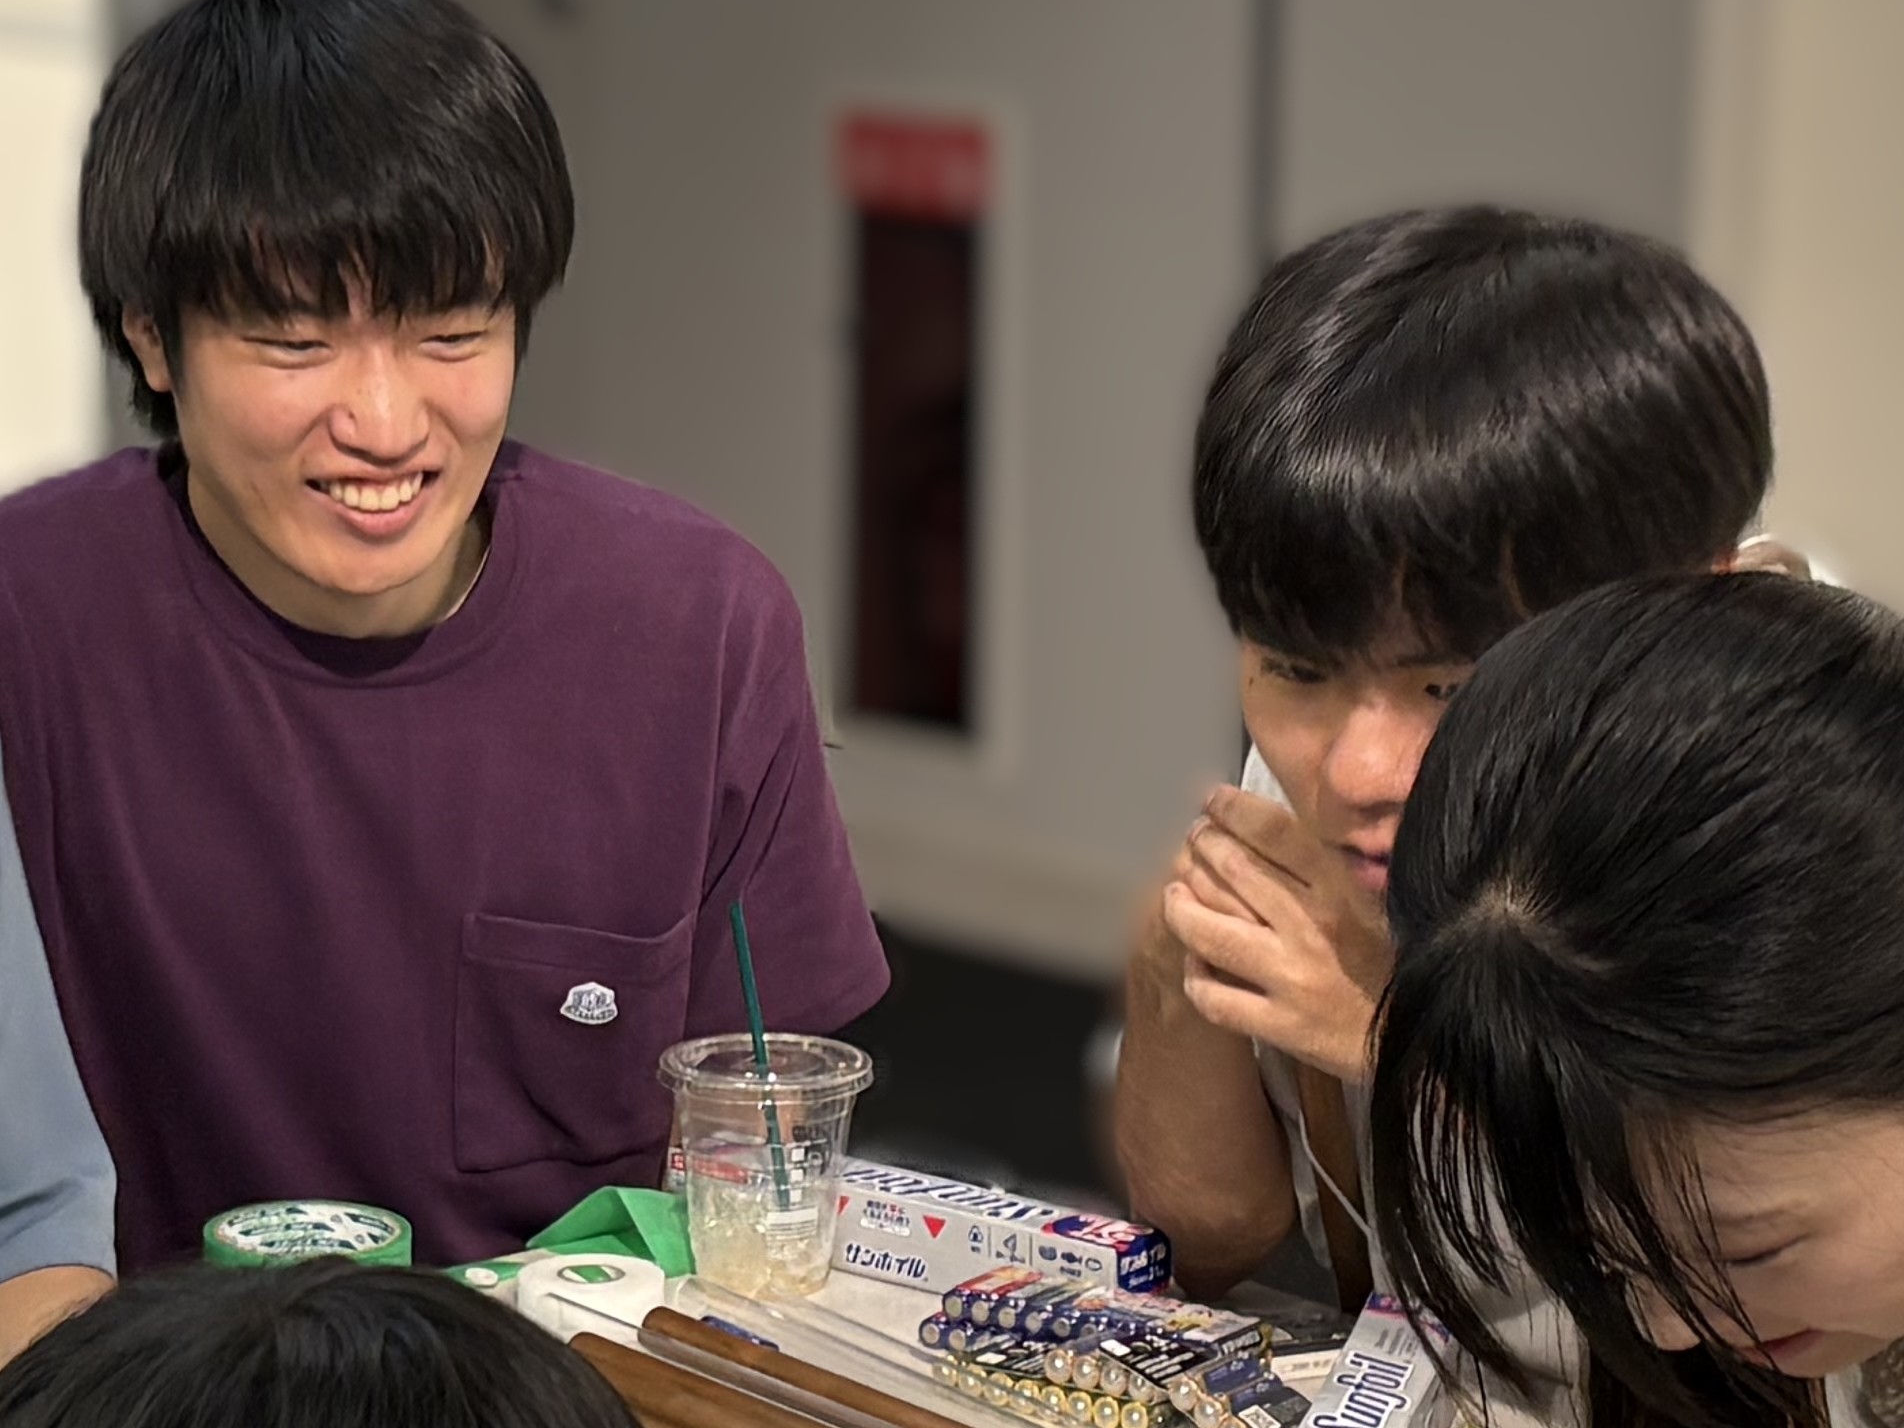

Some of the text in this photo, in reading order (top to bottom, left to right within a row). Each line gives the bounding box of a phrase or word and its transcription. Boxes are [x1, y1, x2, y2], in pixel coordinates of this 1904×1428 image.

[845, 1242, 927, 1280] サンホイル
